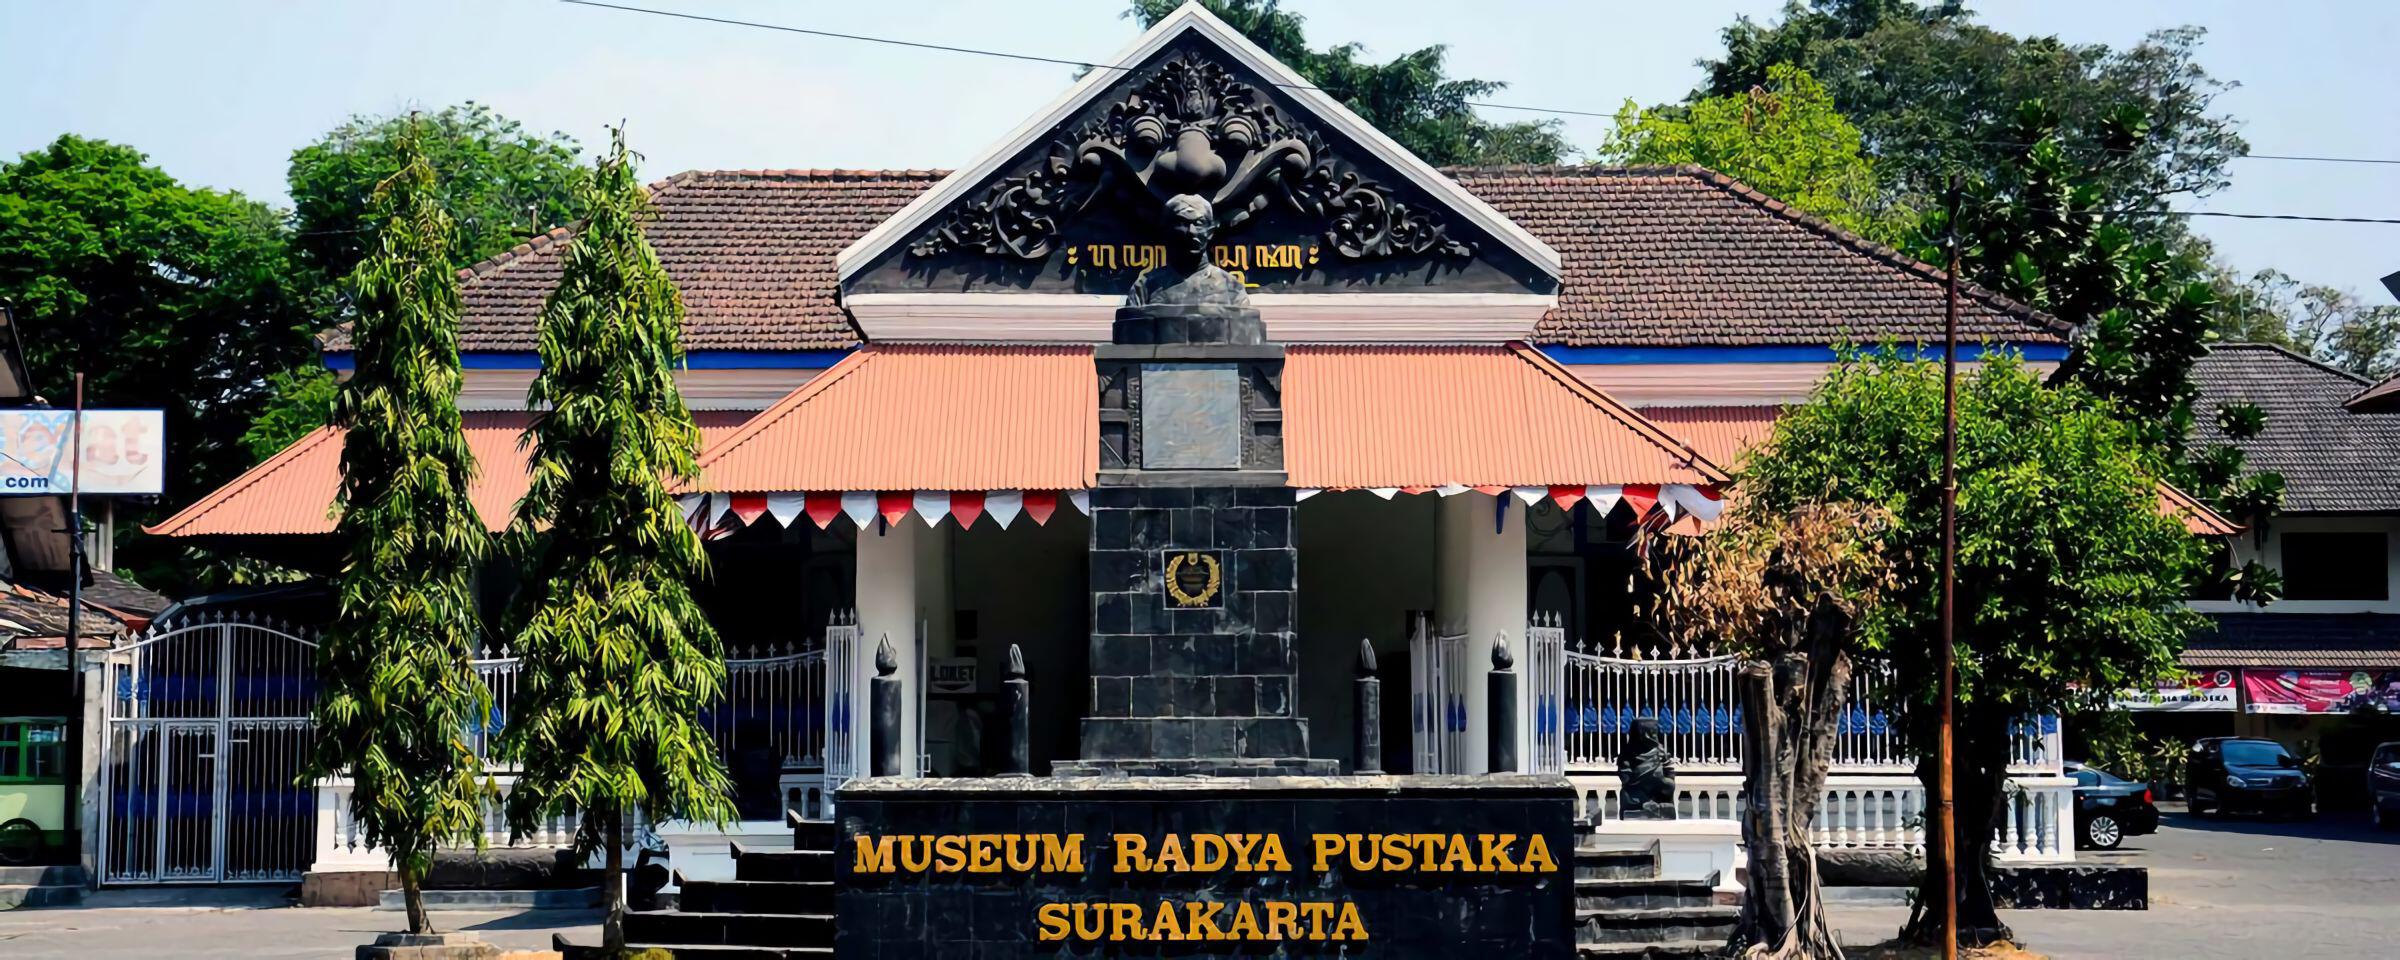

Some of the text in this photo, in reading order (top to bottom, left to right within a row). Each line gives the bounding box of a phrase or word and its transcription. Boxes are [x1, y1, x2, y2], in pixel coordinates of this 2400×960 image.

[853, 833, 1559, 874] MUSEUM RADYA PUSTAKA
[1037, 902, 1370, 942] SURAKARTA
